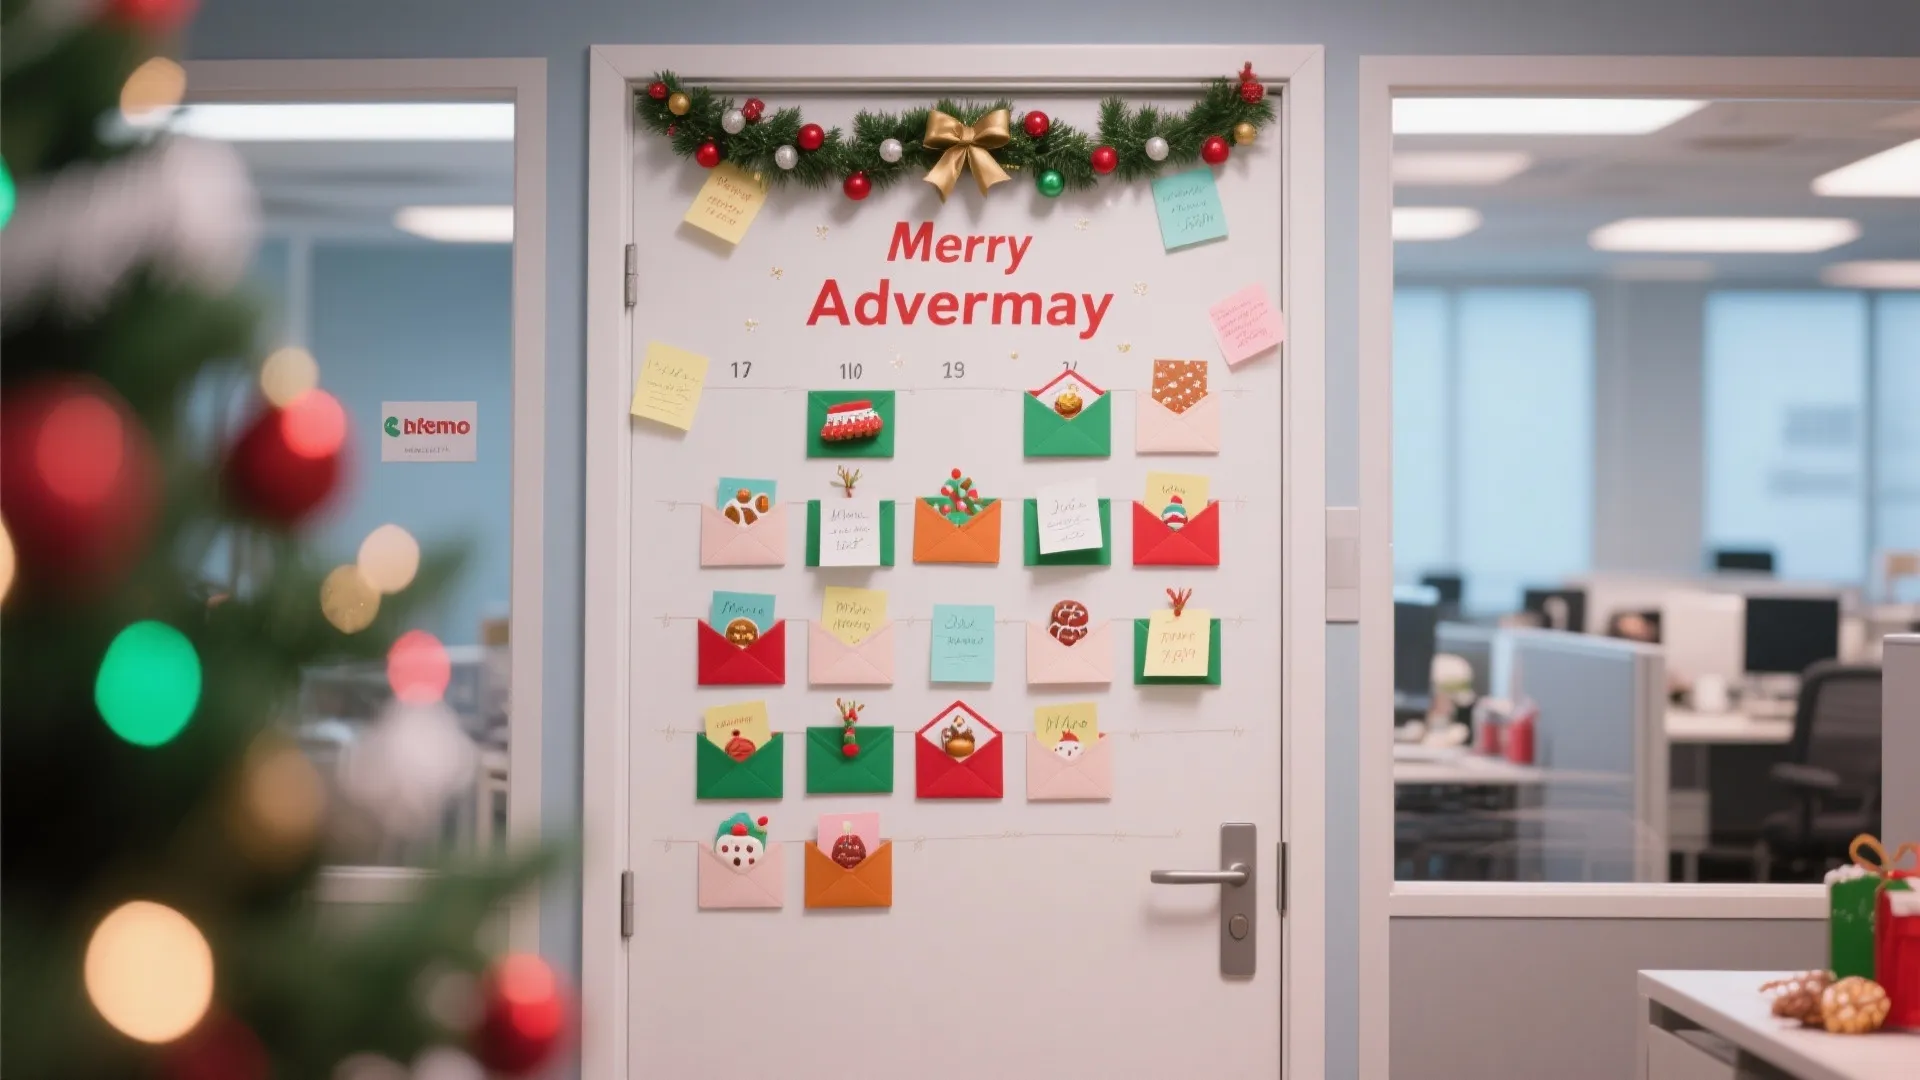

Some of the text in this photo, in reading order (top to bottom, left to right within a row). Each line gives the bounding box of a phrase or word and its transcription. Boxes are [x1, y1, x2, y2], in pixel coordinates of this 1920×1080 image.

[887, 221, 1033, 275] Merry
[806, 279, 1114, 340] Advermay
[730, 361, 752, 379] 17
